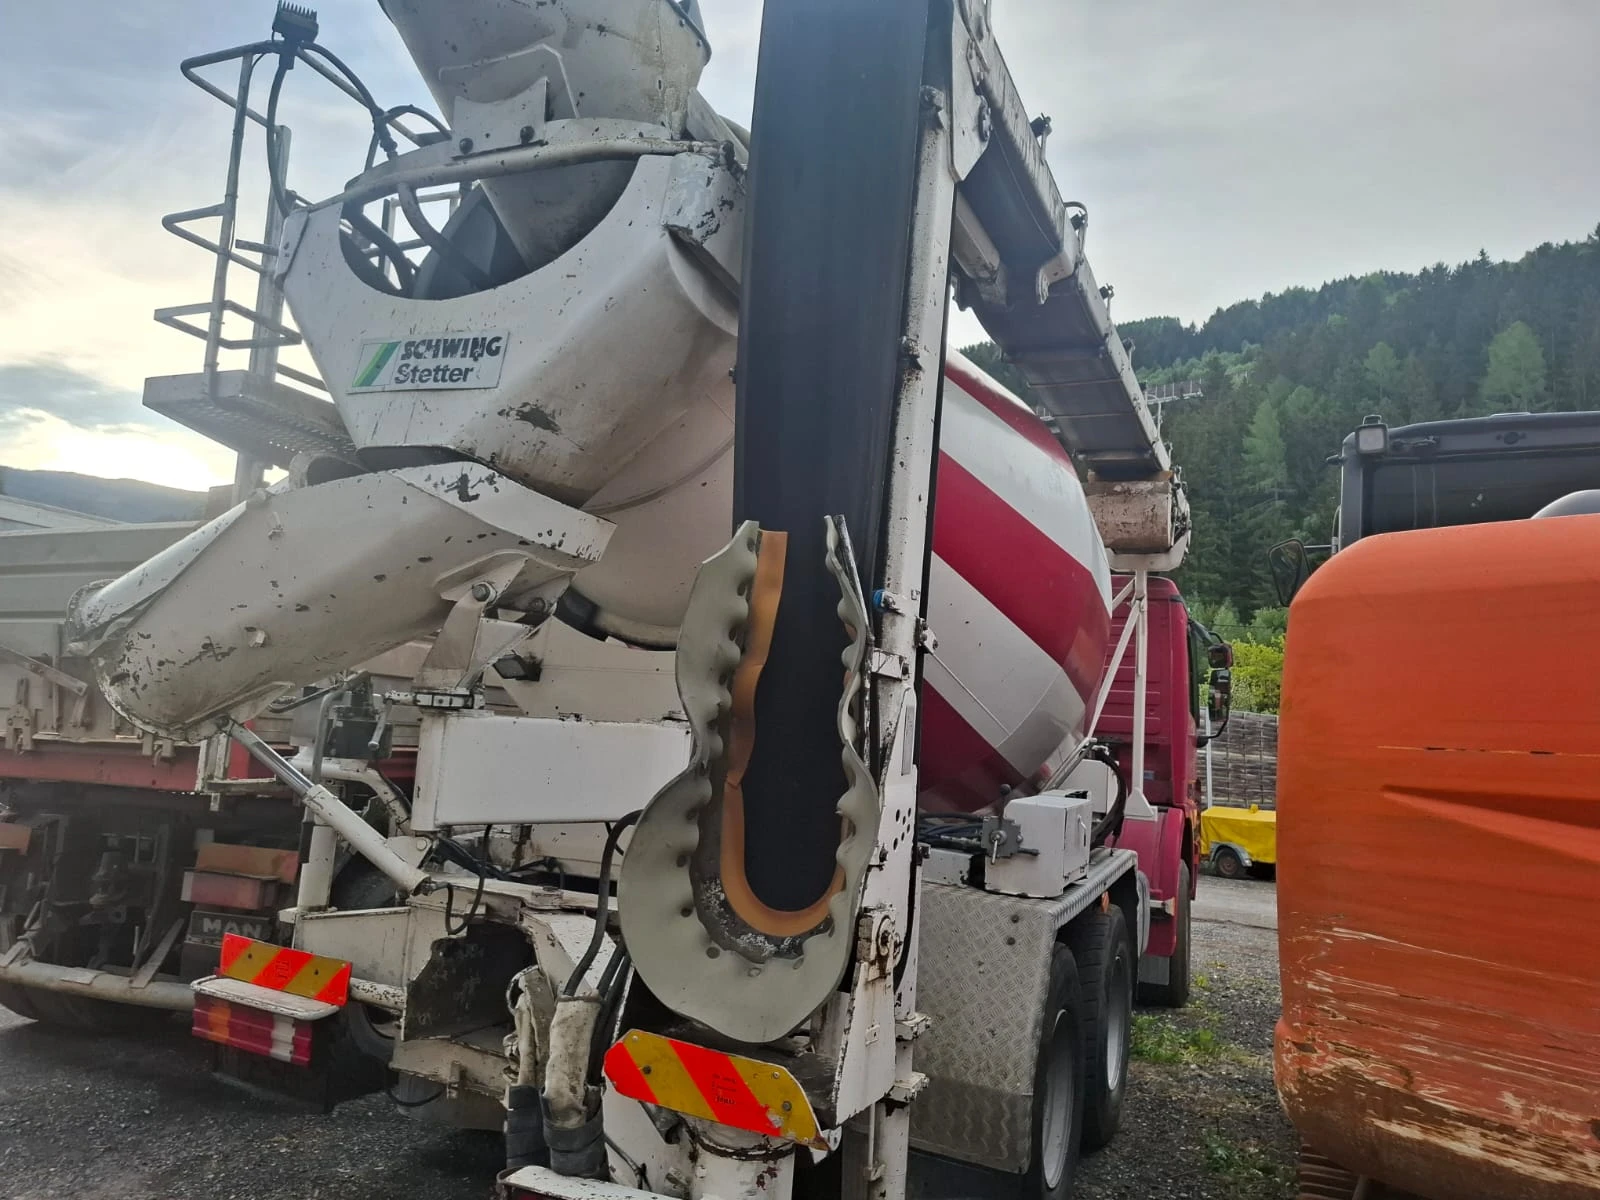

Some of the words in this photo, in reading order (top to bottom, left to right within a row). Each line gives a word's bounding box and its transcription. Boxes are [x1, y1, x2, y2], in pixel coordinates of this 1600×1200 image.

[401, 336, 503, 361] SCHWING
[394, 363, 474, 384] Stetter
[202, 917, 263, 939] MAN
